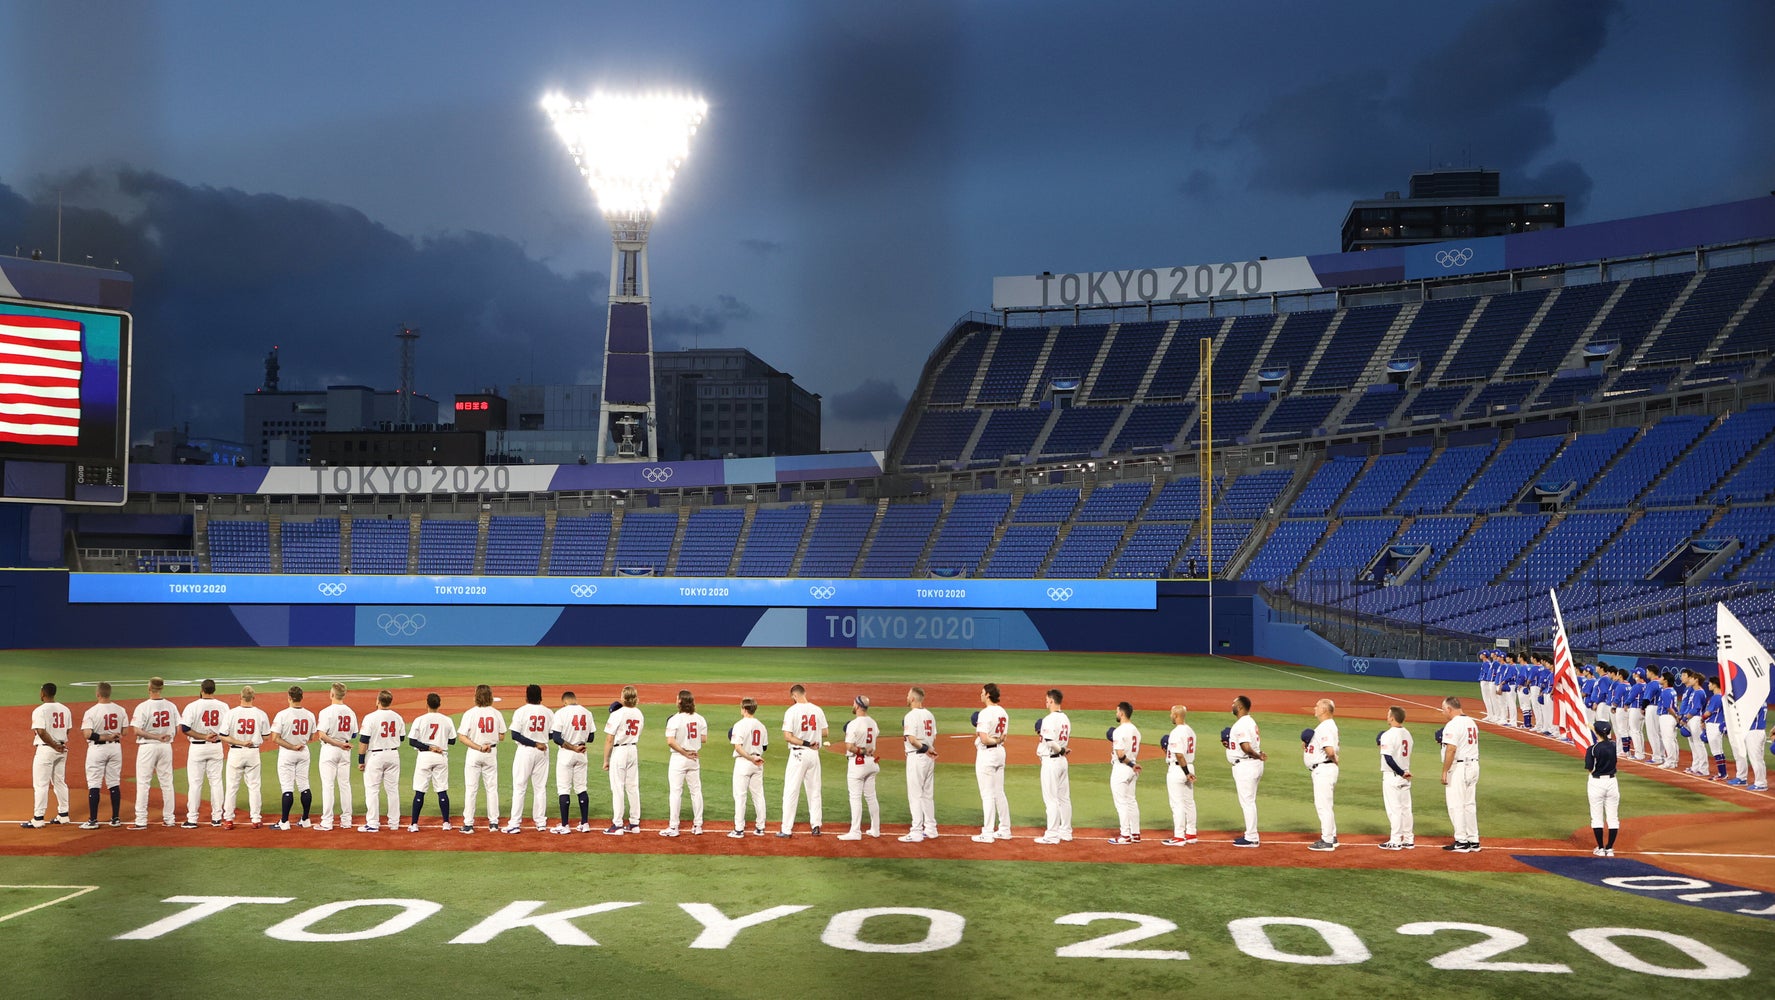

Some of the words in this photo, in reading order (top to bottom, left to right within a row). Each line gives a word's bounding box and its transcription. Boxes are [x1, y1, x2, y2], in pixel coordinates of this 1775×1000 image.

[1036, 268, 1158, 306] TOKYO
[1169, 260, 1262, 300] 2020
[310, 465, 422, 494] TOKYO
[431, 465, 510, 493] 2020
[169, 584, 201, 593] TOKYO
[203, 584, 227, 593] 2020
[434, 586, 464, 595] TOKYO
[465, 586, 487, 595] 2020
[680, 587, 707, 596] TOKYO
[708, 587, 729, 596] 2020
[916, 589, 944, 598] TOKYO
[945, 589, 966, 598] 2020
[825, 615, 908, 638] TOKYO
[914, 616, 974, 640] 2020
[52, 712, 65, 729] 31
[103, 713, 118, 730] 16
[153, 711, 170, 728] 32
[202, 710, 219, 727] 48
[237, 718, 255, 735] 39
[478, 716, 494, 733] 40
[529, 715, 546, 732] 33
[571, 715, 587, 731] 44
[801, 714, 817, 732] 24
[292, 719, 309, 736] 30
[381, 721, 396, 738] 34
[429, 723, 439, 740] 7
[625, 719, 640, 736] 35
[687, 722, 697, 739] 15
[866, 728, 873, 744] 5
[752, 729, 761, 746] 0
[1131, 736, 1137, 753] 2
[1402, 740, 1408, 757] 3
[115, 896, 965, 952] TOKYO
[1054, 910, 1749, 980] 2020
